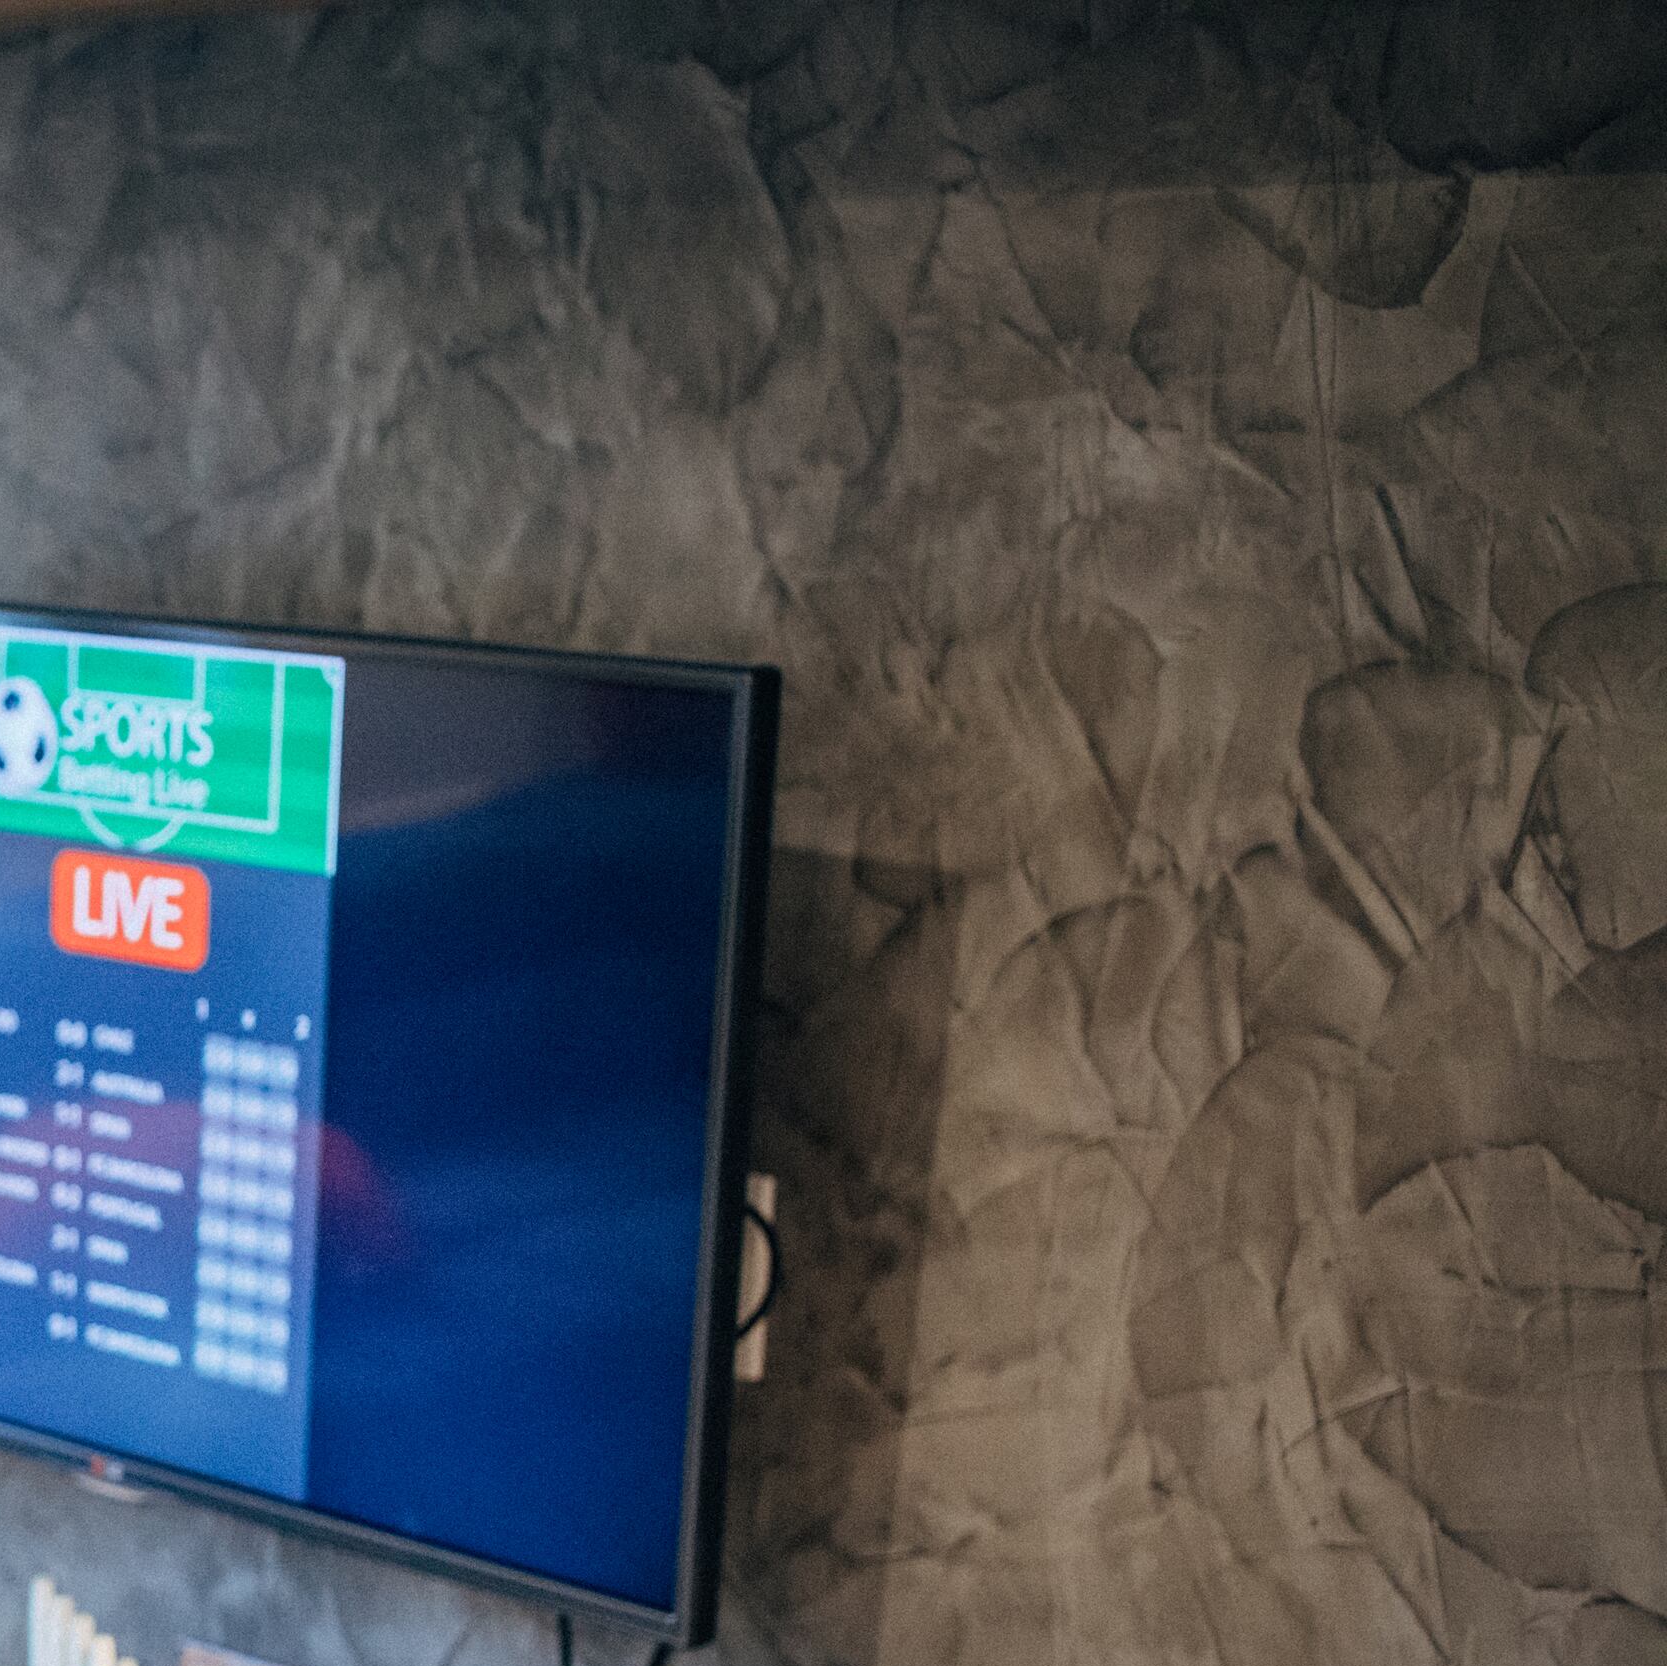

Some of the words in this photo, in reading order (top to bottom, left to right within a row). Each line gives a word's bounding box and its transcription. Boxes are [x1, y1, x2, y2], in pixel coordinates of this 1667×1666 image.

[59, 696, 214, 767] SPORTS
[152, 767, 210, 812] Live
[72, 864, 186, 951] LIVE
